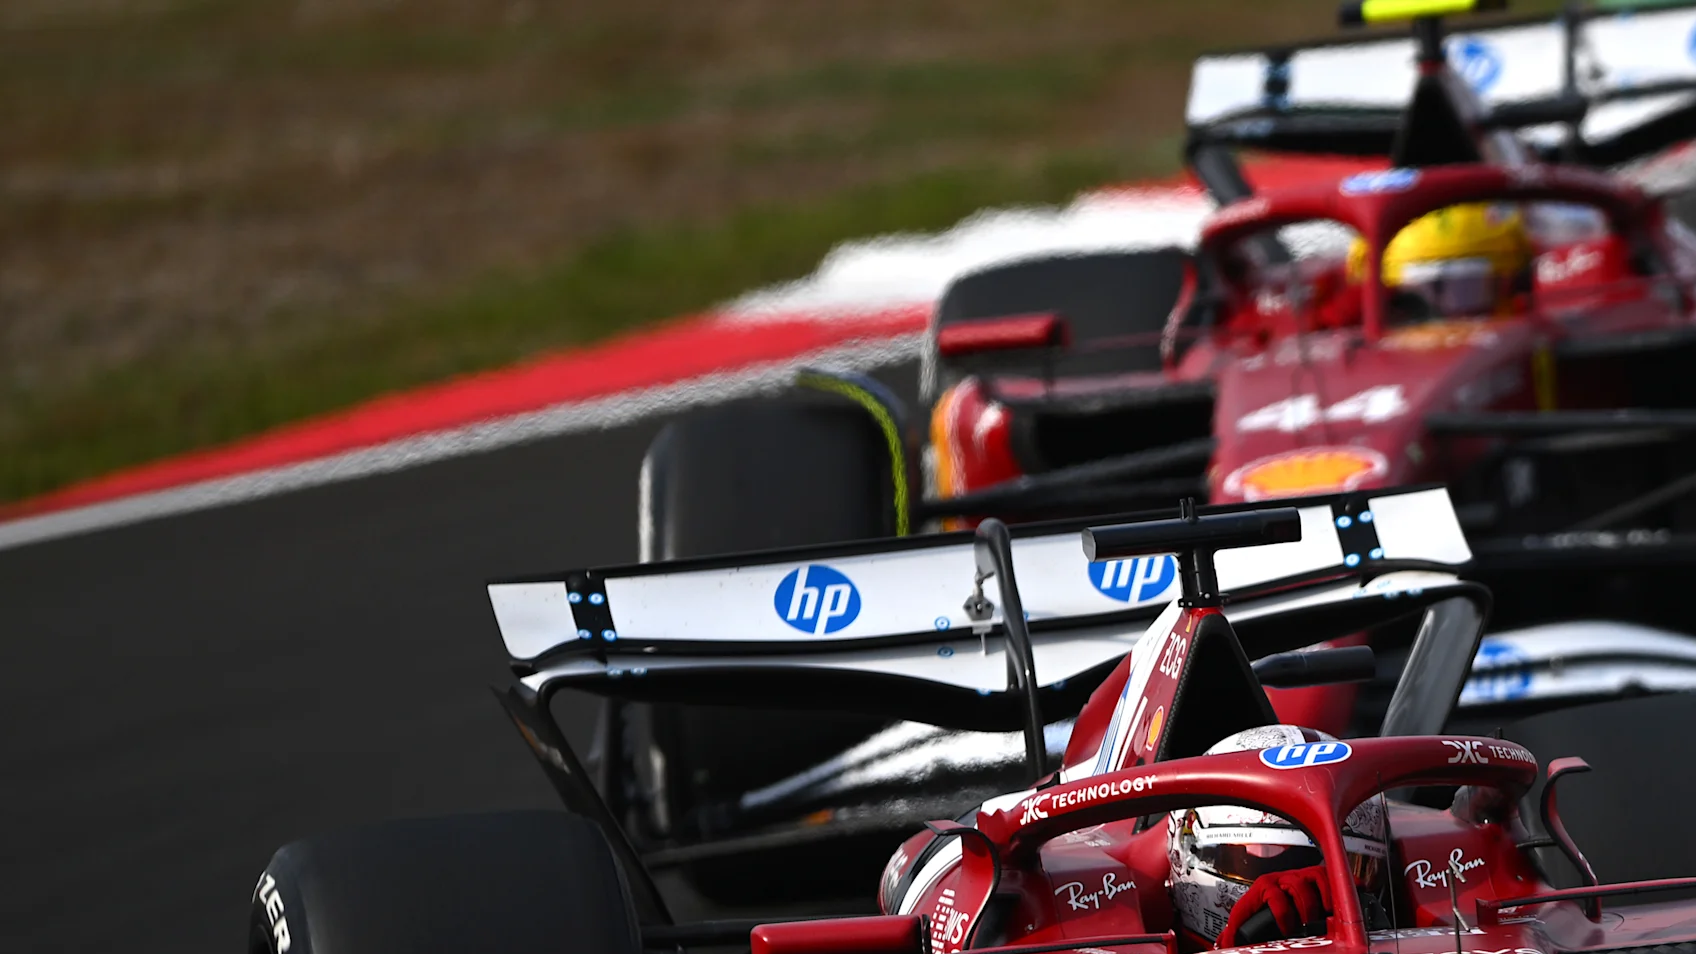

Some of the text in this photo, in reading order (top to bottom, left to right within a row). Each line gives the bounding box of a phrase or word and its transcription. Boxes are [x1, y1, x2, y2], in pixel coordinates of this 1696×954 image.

[1235, 383, 1409, 432] 44
[786, 564, 852, 636] hp
[1276, 743, 1336, 765] hp
[1441, 740, 1489, 764] DXC
[1051, 774, 1158, 809] TECHNOLOGY
[1403, 848, 1486, 889] Ray-Ban
[1054, 872, 1137, 911] Ray-Ban
